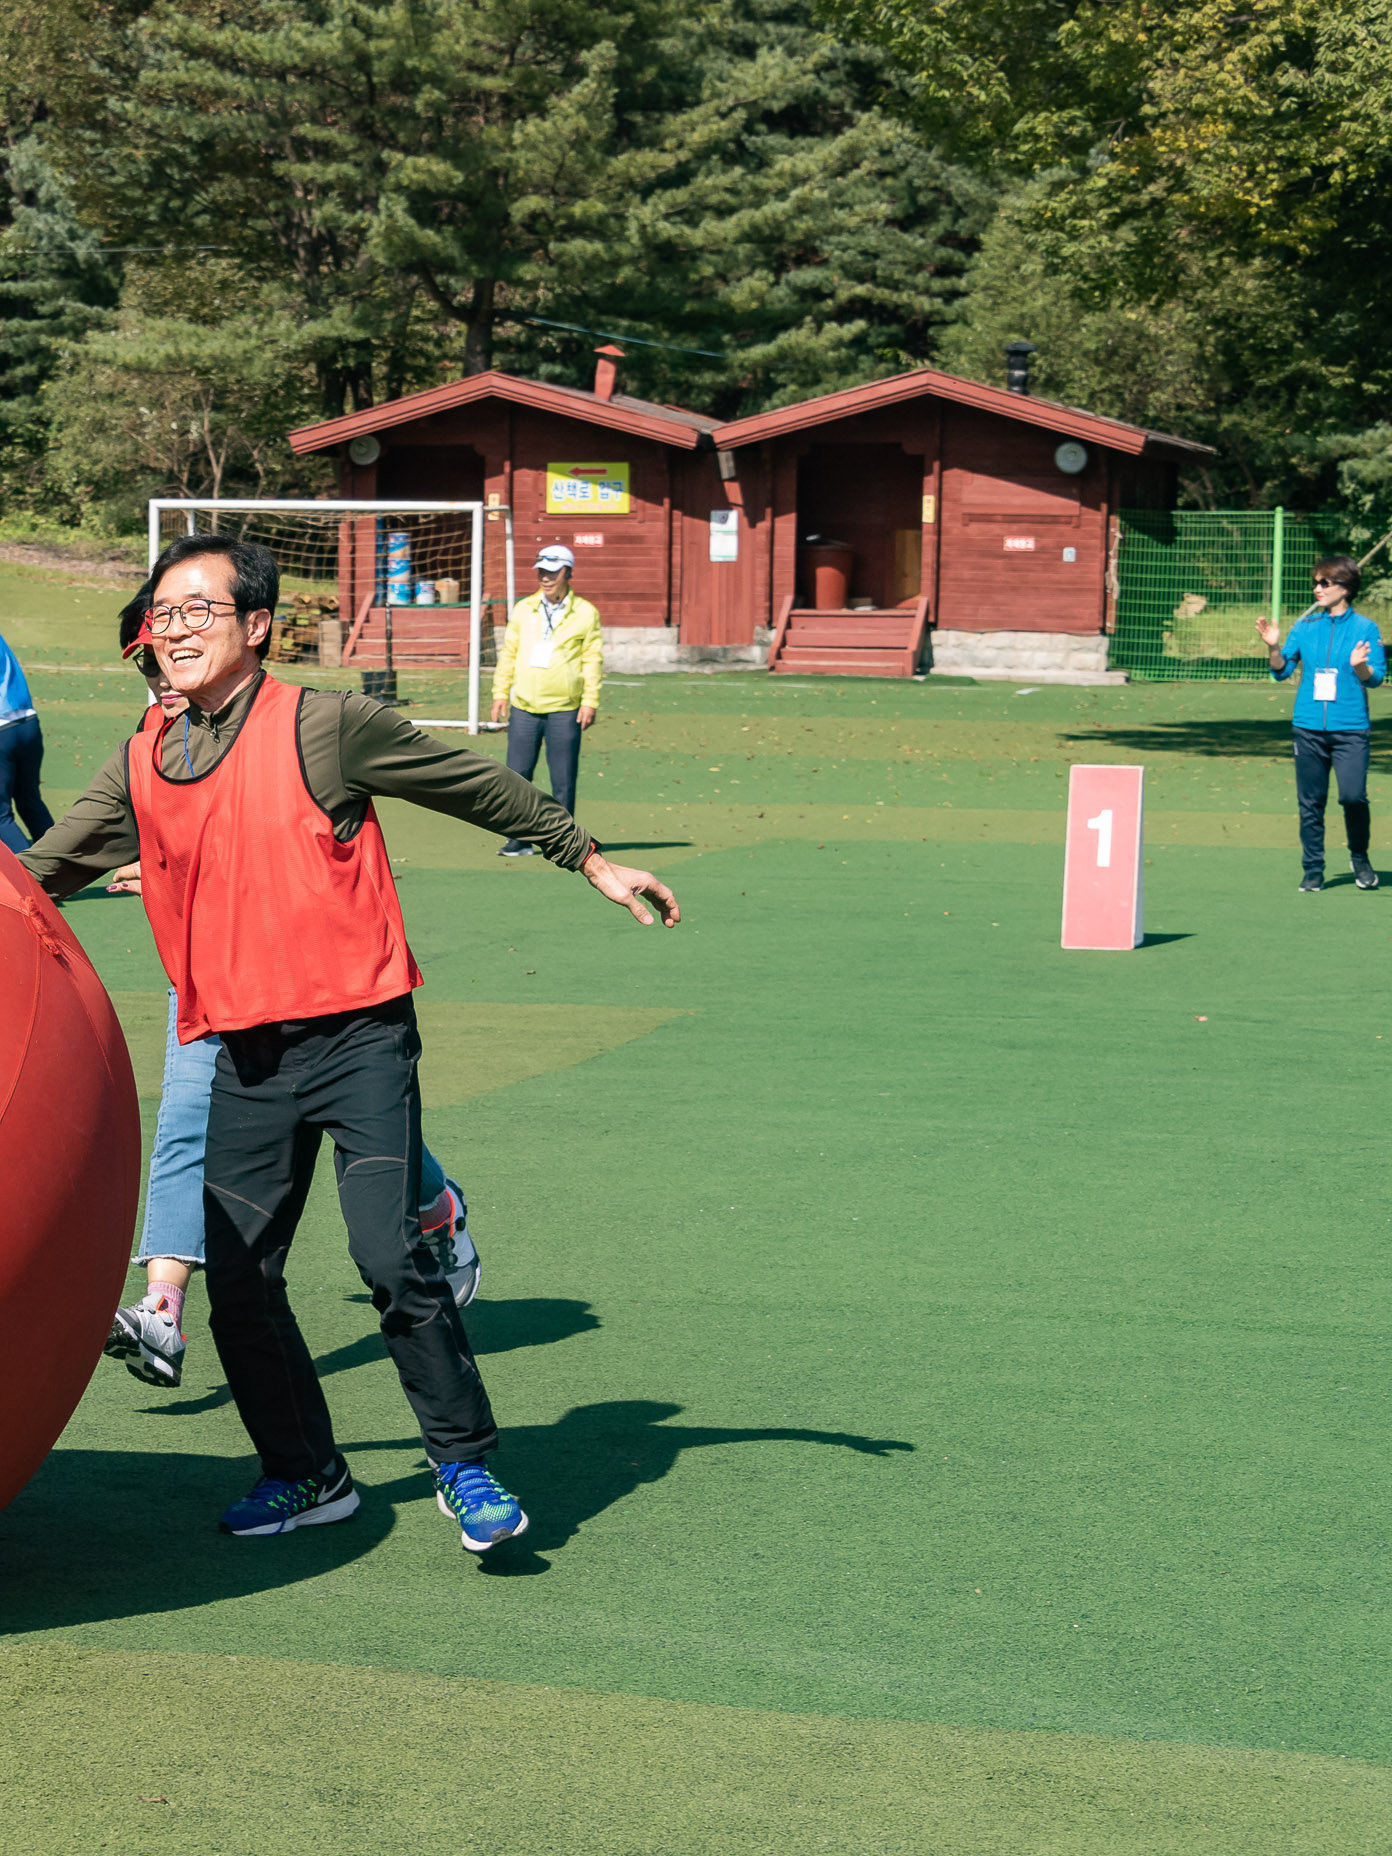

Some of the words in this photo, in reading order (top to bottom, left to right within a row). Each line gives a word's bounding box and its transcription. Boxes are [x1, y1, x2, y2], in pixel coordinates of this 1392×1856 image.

[552, 480, 591, 500] 산책로
[599, 480, 624, 500] 입구
[1087, 809, 1113, 868] 1
